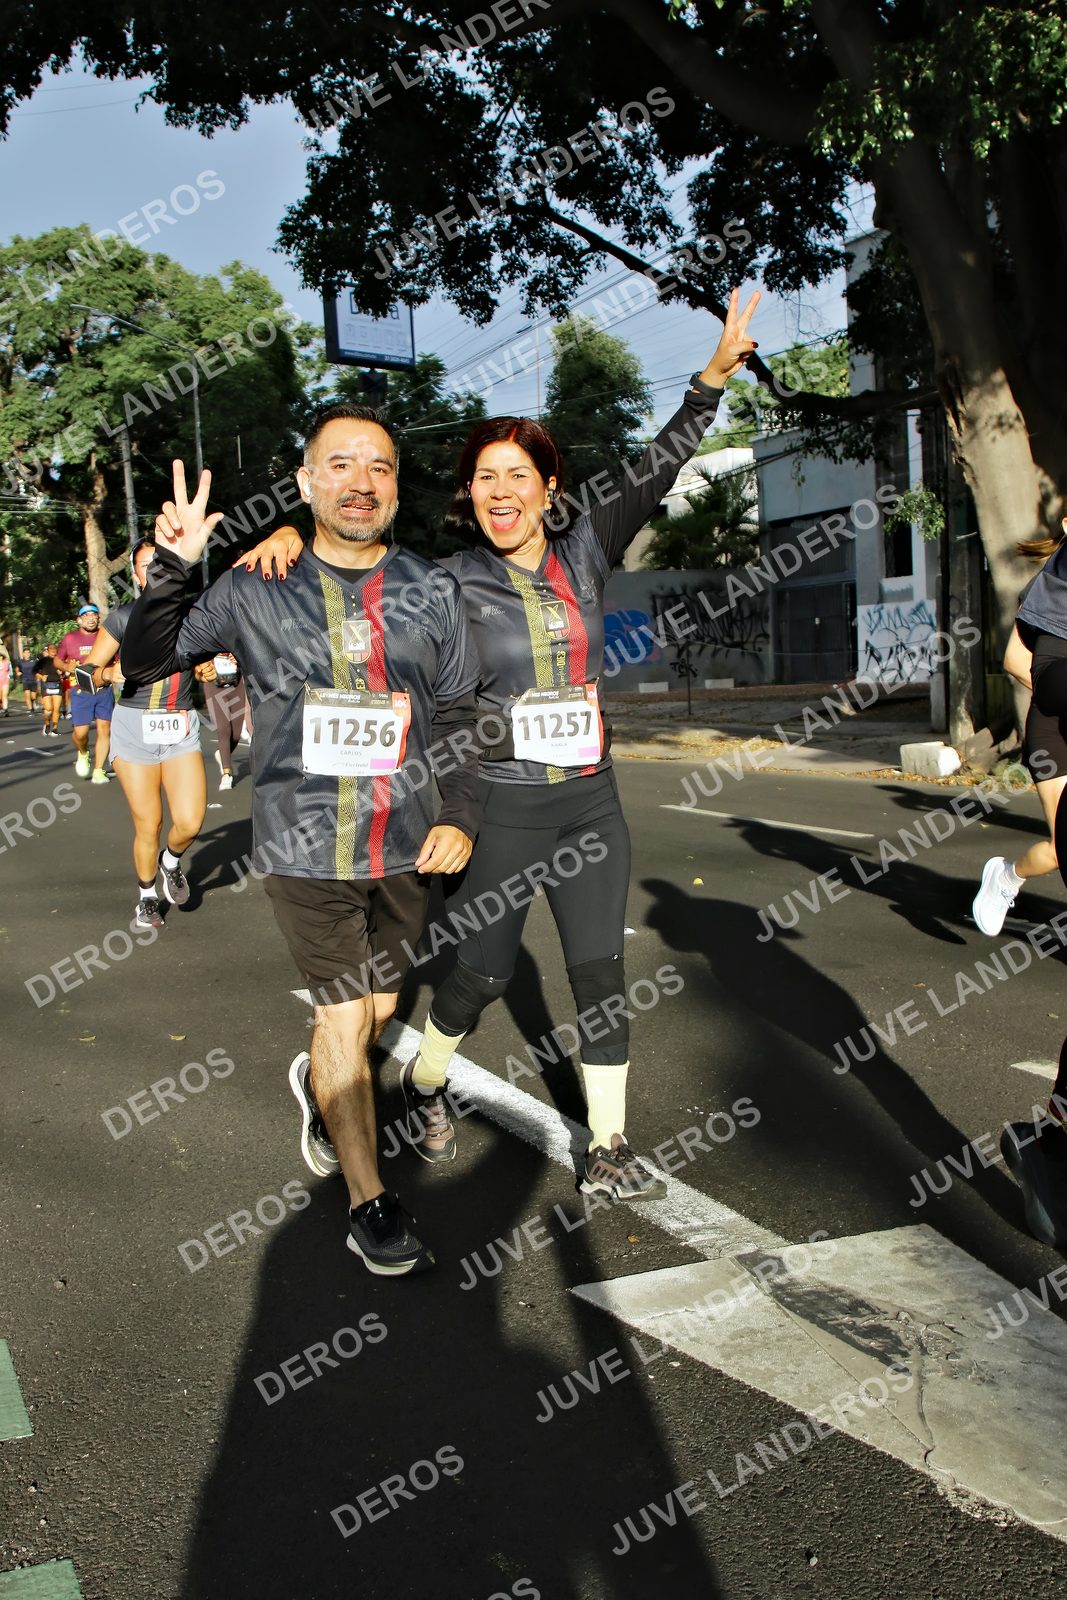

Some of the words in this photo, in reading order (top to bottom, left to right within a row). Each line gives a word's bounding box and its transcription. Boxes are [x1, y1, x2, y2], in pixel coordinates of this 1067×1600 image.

[149, 718, 180, 732] 9410
[309, 717, 396, 748] 11256
[518, 711, 592, 741] 11257
